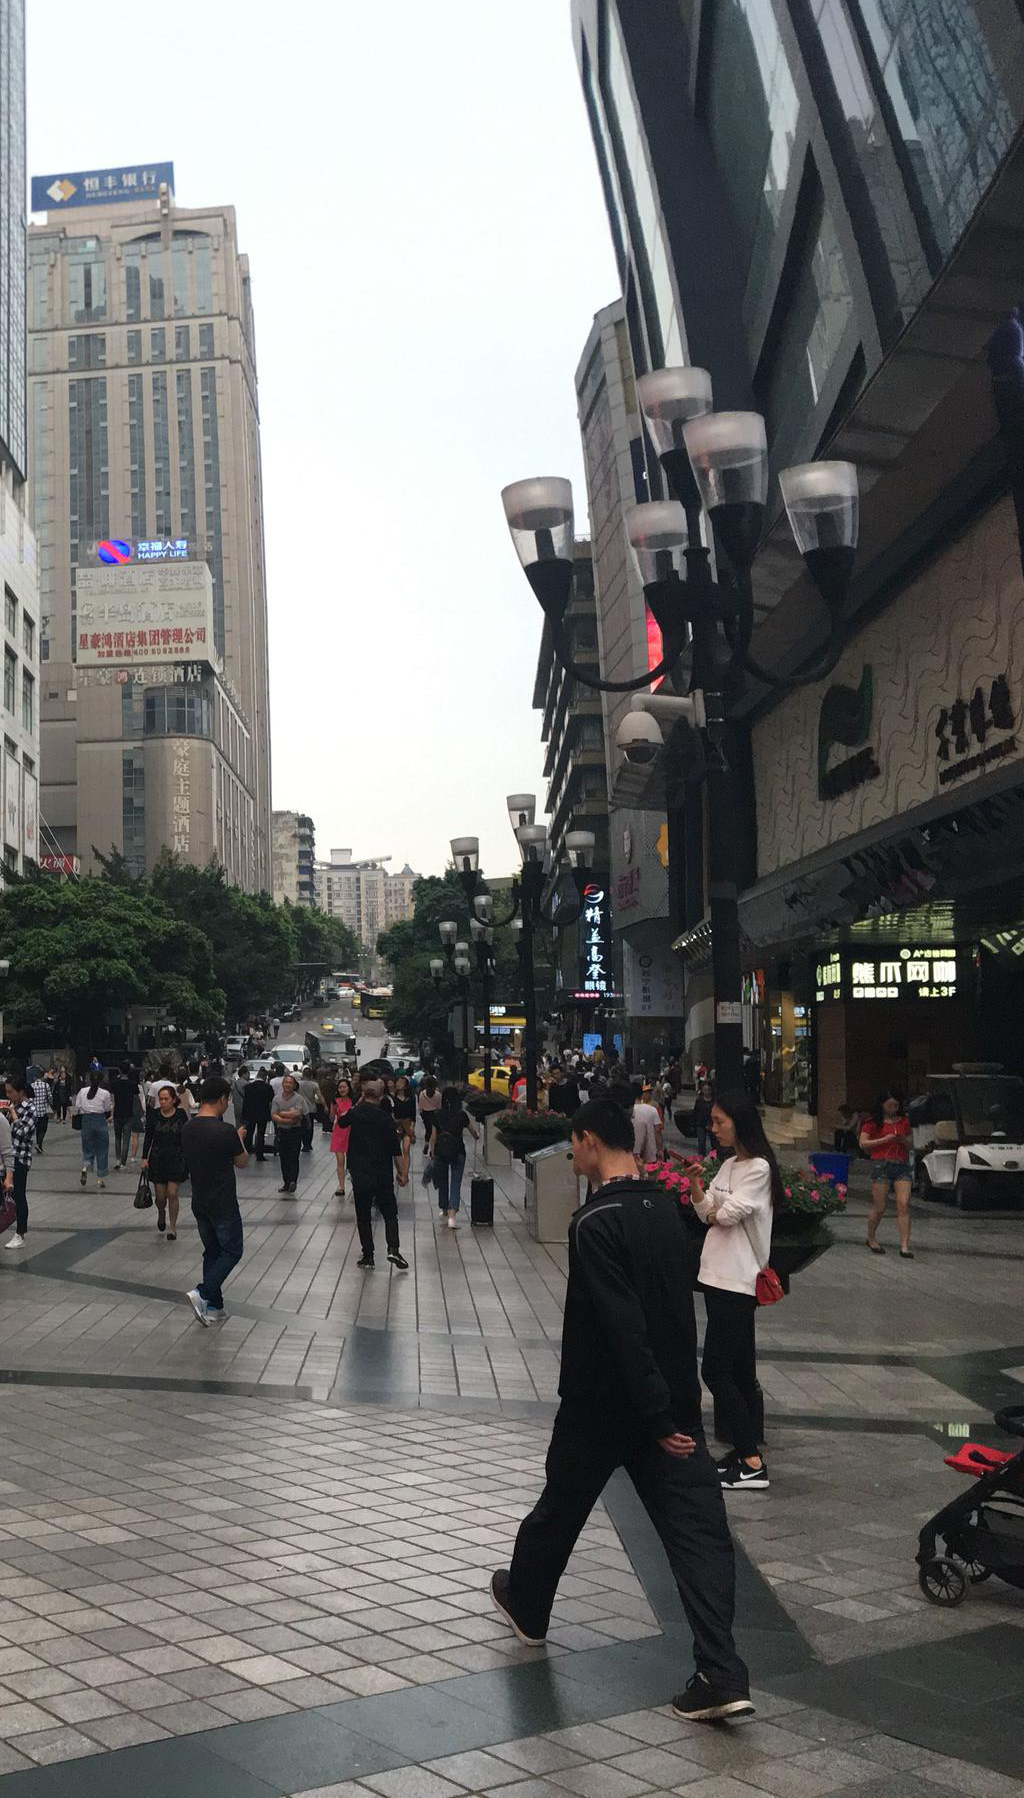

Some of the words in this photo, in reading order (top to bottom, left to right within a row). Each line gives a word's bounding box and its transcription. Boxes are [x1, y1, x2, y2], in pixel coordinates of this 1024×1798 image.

[83, 170, 157, 192] 恒丰银行
[137, 539, 187, 551] 幸福人寿
[137, 550, 166, 560] HAPPY
[169, 548, 188, 557] LIFE
